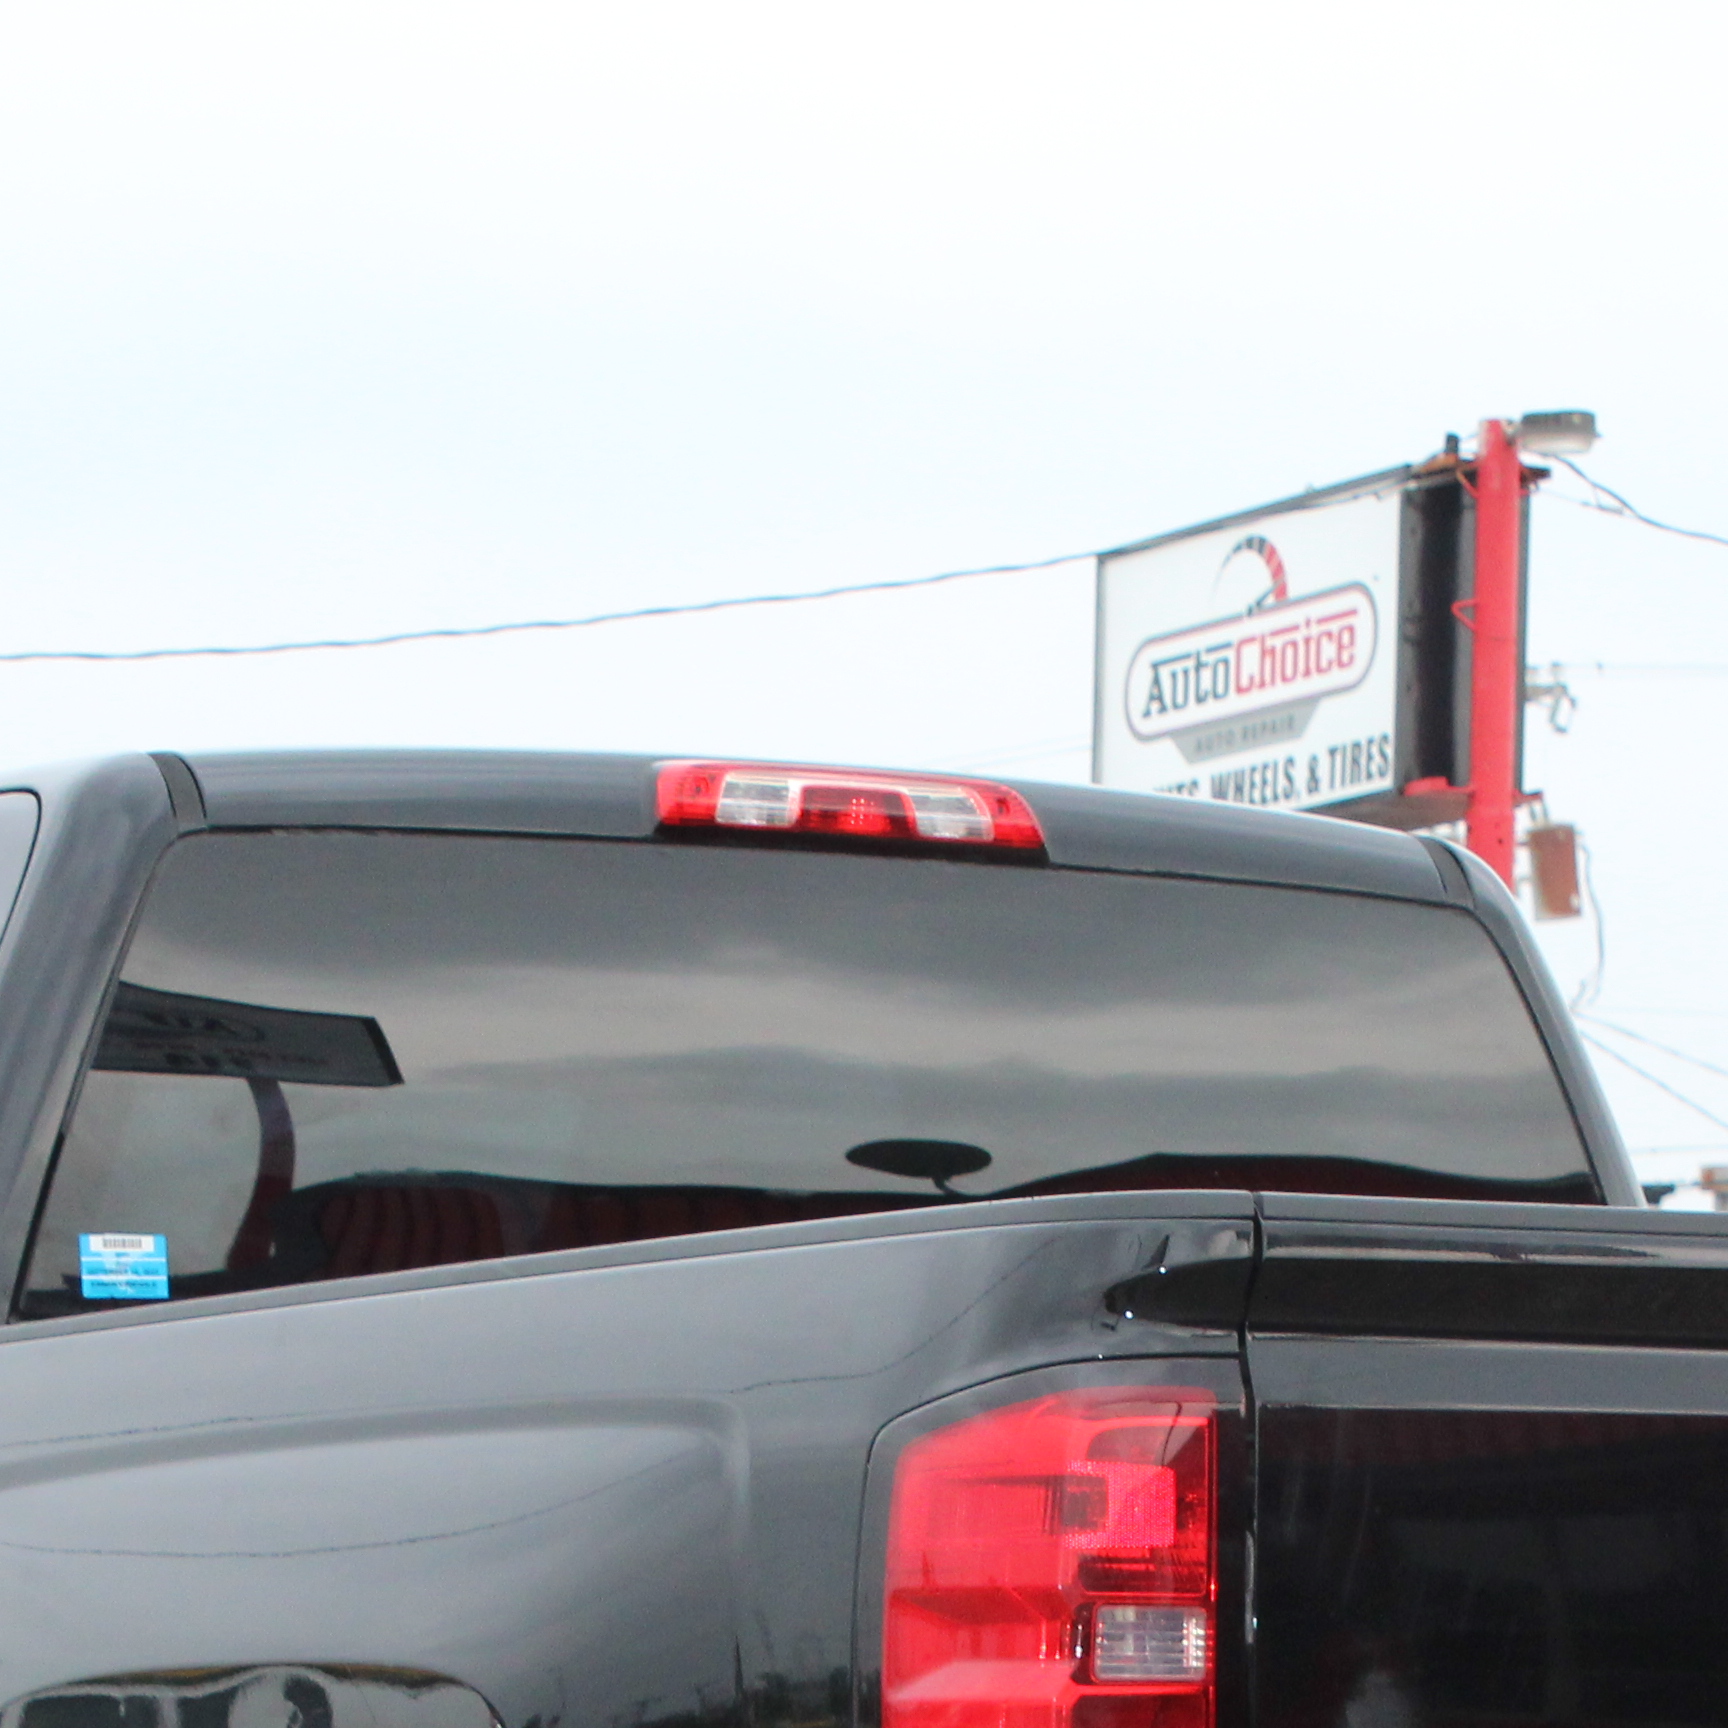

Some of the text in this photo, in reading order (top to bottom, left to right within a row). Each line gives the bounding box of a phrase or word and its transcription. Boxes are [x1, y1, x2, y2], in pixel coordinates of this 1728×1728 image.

[1142, 609, 1358, 718] AutoChoice
[1307, 753, 1320, 795] &
[1328, 731, 1391, 790] TIRES
